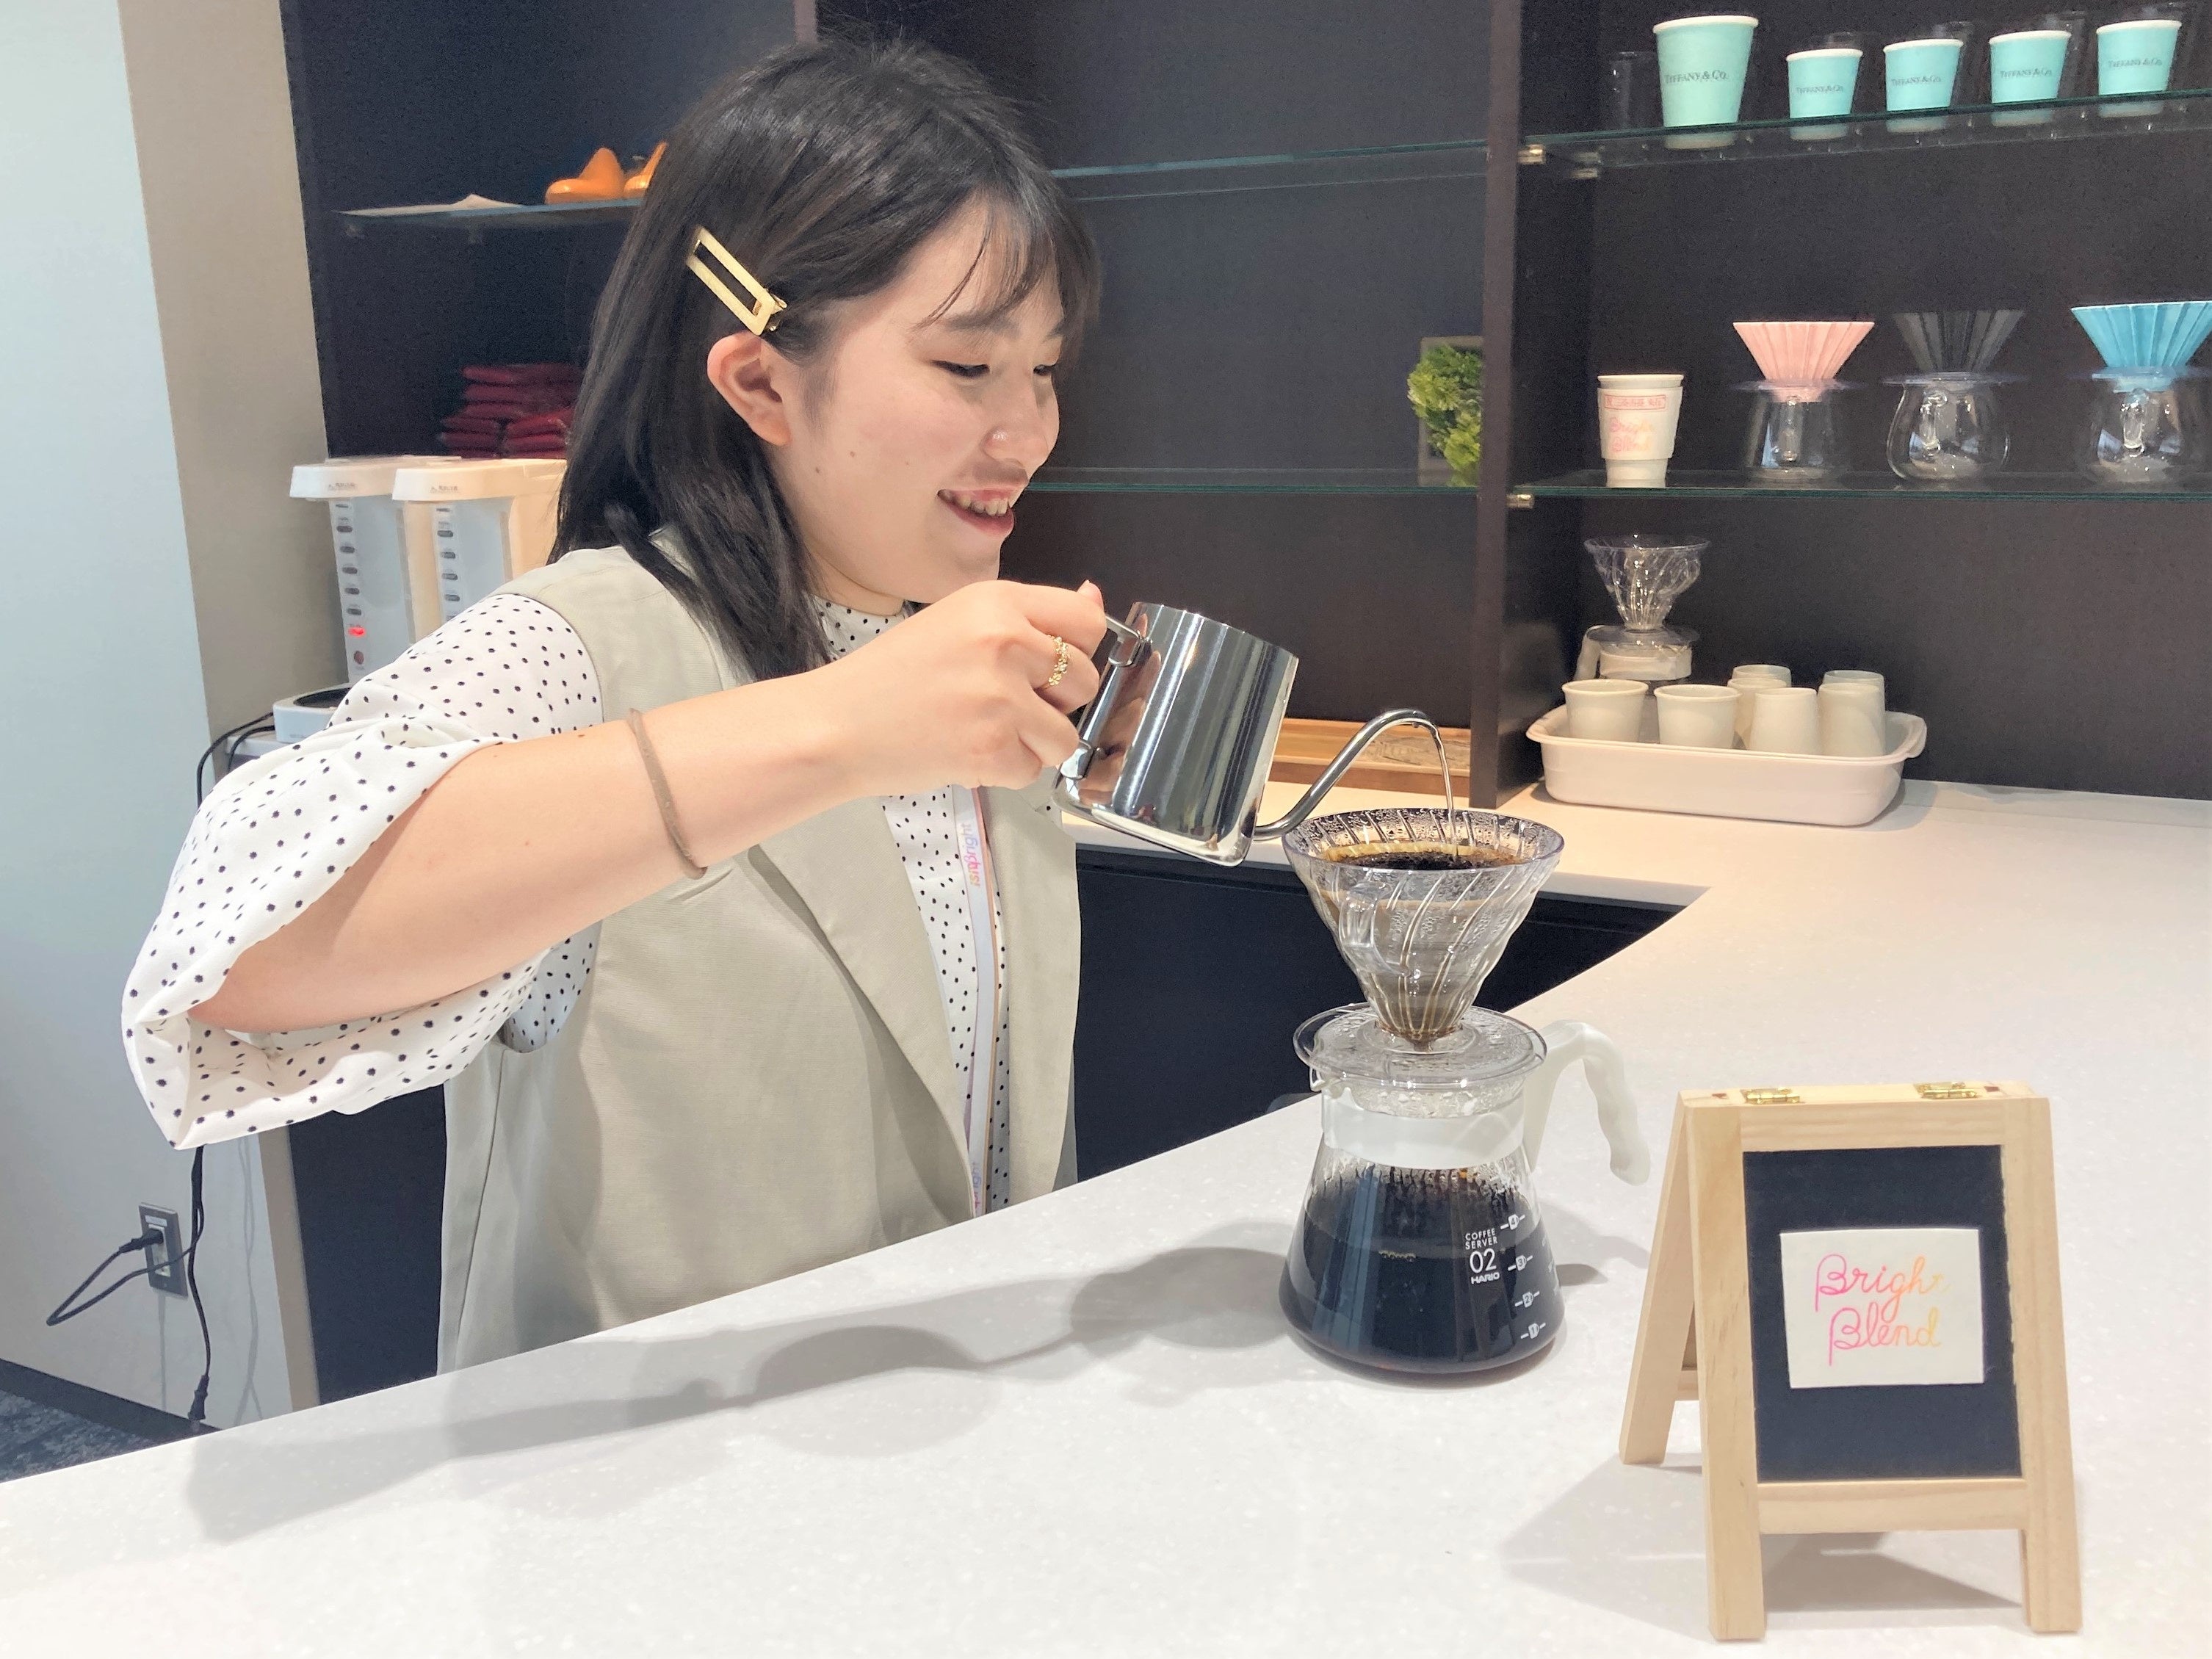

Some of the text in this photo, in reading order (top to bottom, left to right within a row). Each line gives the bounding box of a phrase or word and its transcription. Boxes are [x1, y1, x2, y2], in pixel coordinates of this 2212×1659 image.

[1665, 72, 1700, 84] TIFFANY
[1702, 71, 1710, 79] &
[1465, 1228, 1496, 1241] COFFEE
[1465, 1236, 1498, 1250] SERVER
[1470, 1248, 1497, 1273] 02
[1470, 1272, 1500, 1284] HARIO
[1828, 1301, 1941, 1367] Blend
